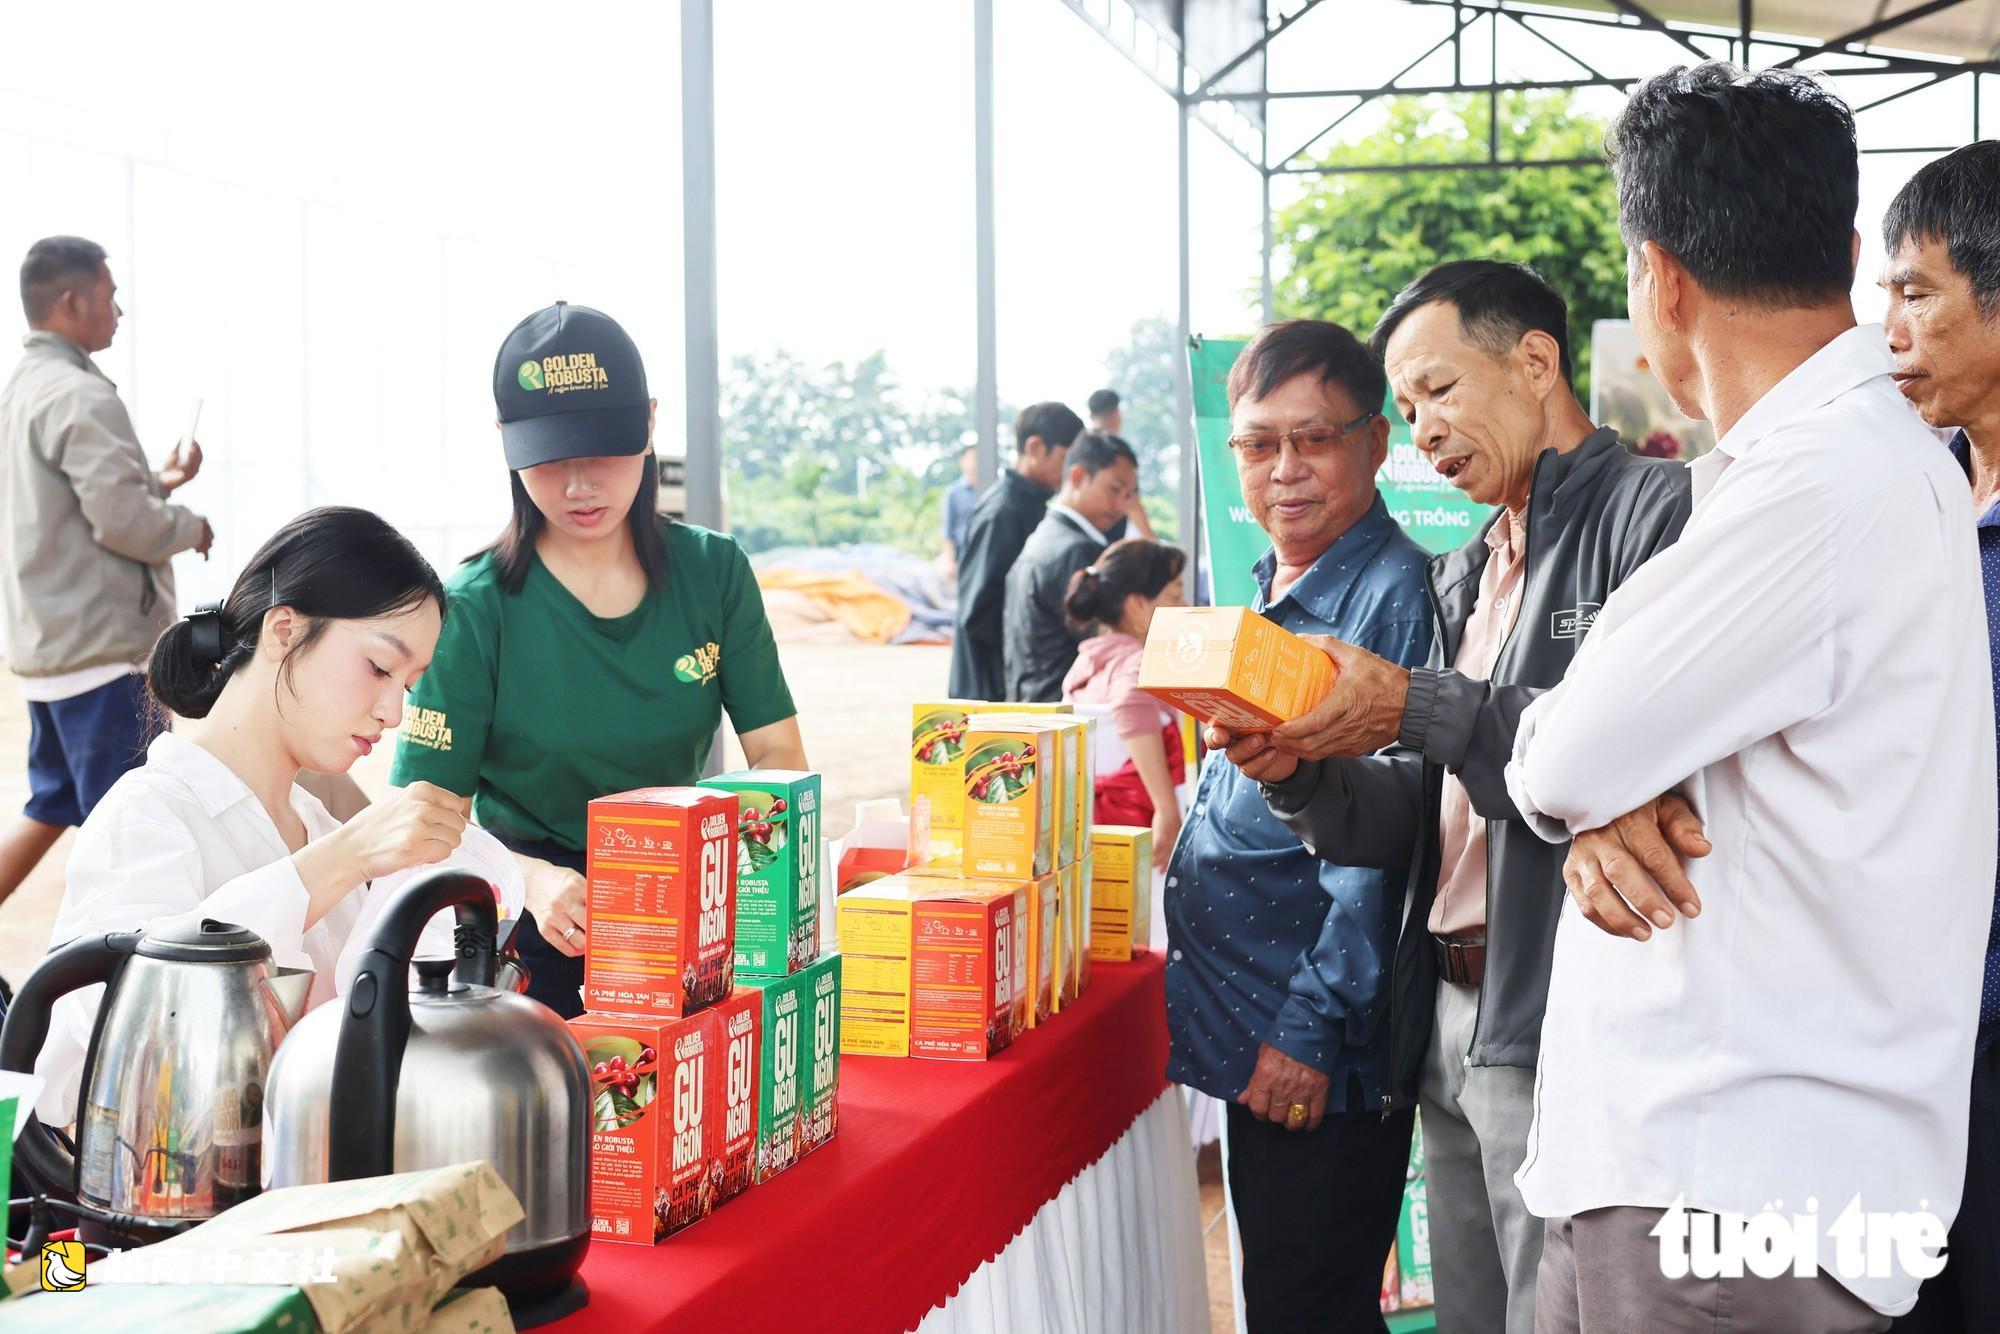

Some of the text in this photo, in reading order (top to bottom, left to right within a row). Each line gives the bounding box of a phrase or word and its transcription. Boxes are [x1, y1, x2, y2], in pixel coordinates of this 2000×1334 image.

[543, 353, 596, 372] GOLDEN
[544, 367, 608, 387] ROBUSTA
[799, 812, 816, 879] GU
[700, 837, 729, 912] GU
[740, 879, 768, 887] ROBUSTA
[698, 905, 727, 948] NGON
[995, 924, 1011, 981] GU
[589, 988, 600, 996] CÀ
[602, 989, 616, 998] PHÊ
[617, 989, 634, 999] HÒA
[774, 1012, 798, 1083] GU
[814, 992, 835, 1062] GU
[727, 1032, 753, 1108] GU
[813, 1053, 834, 1094] NGON
[673, 1055, 704, 1134] GU
[773, 1074, 796, 1117] NGON
[604, 1135, 634, 1145] ROBUSTA
[726, 1098, 751, 1144] NGON
[616, 1145, 635, 1154] THIỆU
[672, 1123, 702, 1172] NGON
